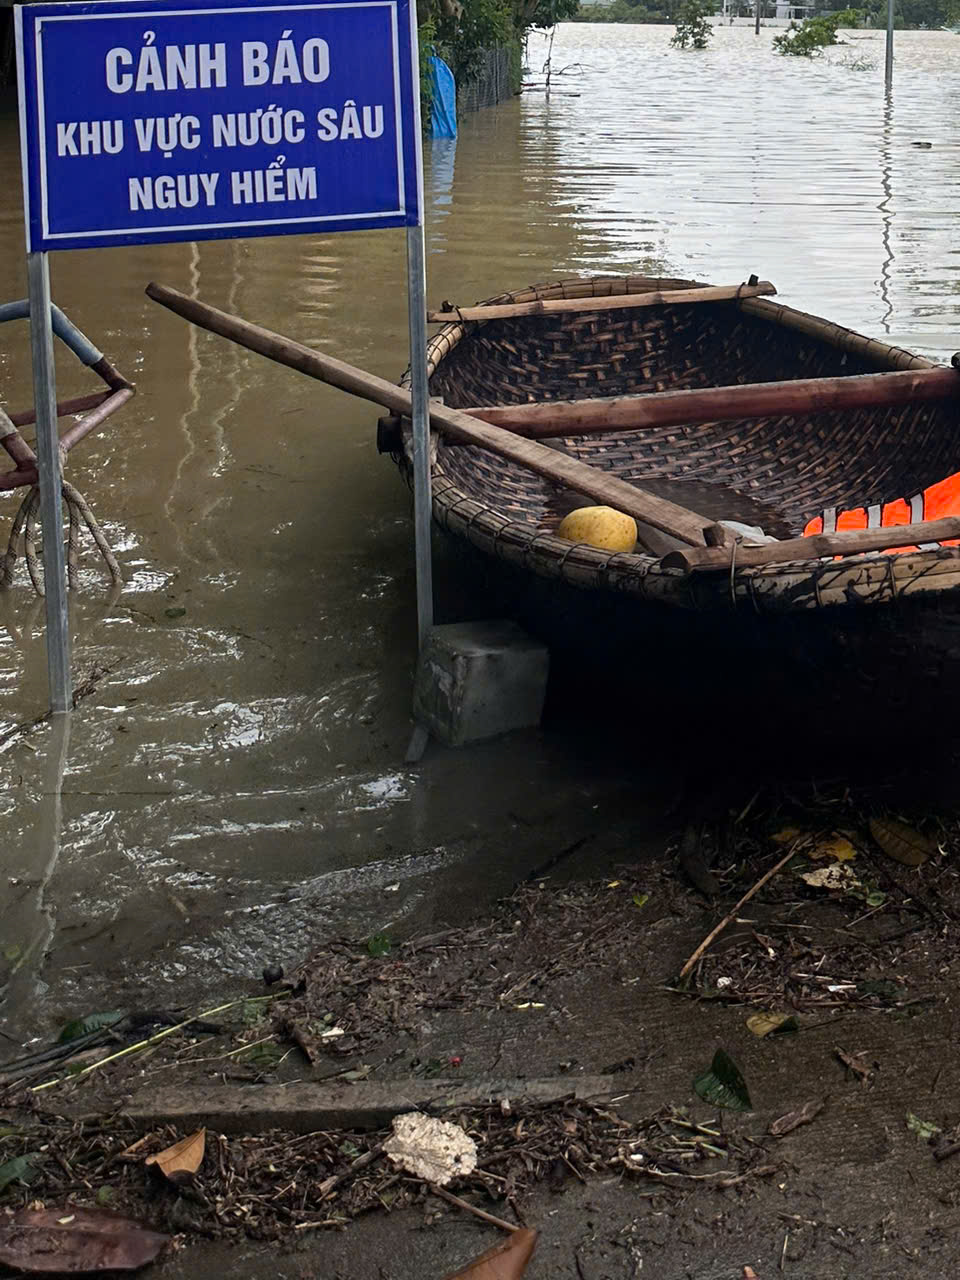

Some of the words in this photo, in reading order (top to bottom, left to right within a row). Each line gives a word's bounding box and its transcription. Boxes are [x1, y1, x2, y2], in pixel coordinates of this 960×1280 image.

[105, 30, 227, 94] CẢNH
[242, 29, 330, 86] BÁO
[57, 120, 124, 157] KHU
[135, 113, 201, 158] VỰC
[213, 104, 305, 148] NƯỚC
[317, 100, 384, 141] SÂU
[129, 173, 220, 211] NGUY
[231, 155, 317, 204] HIỂM
